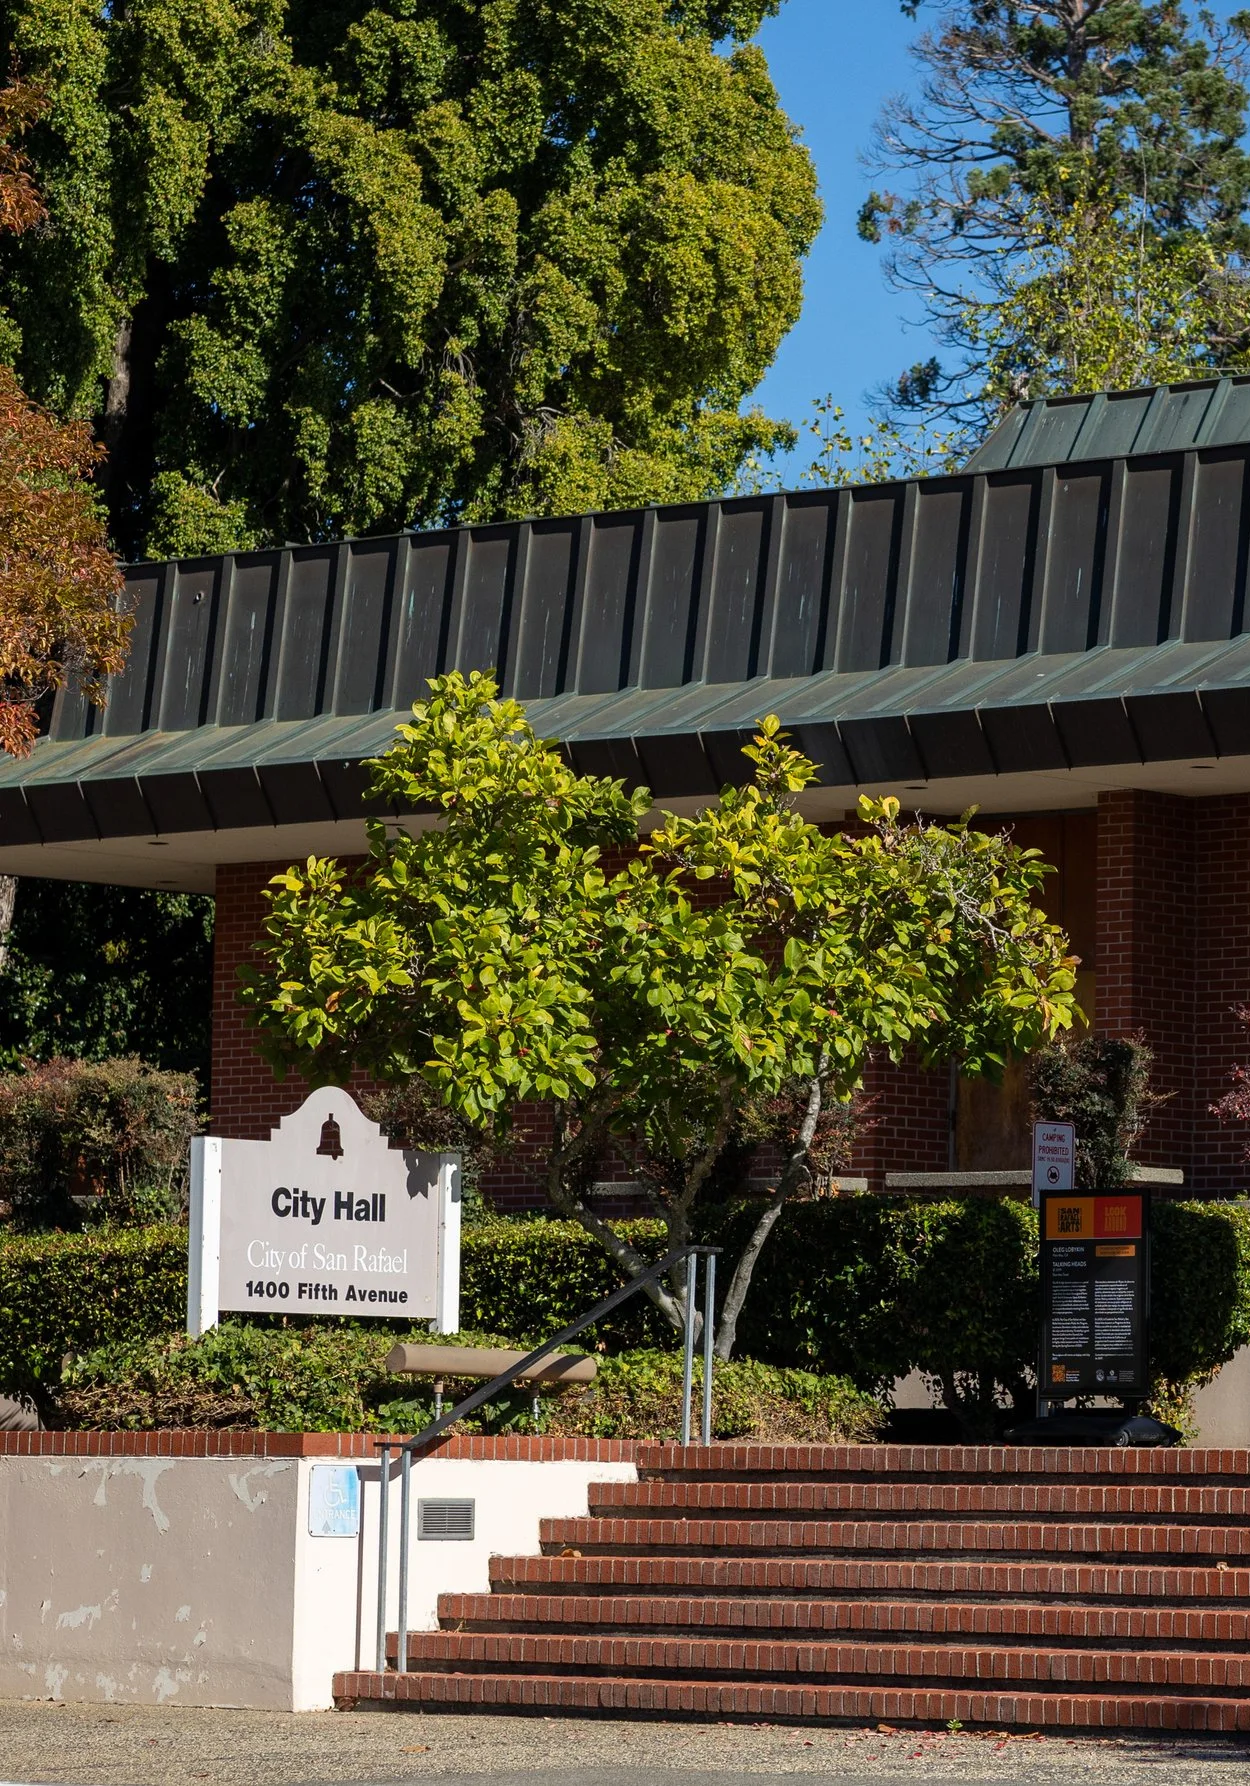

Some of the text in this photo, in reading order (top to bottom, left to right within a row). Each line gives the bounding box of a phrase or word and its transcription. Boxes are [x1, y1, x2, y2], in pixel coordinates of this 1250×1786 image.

[1043, 1133, 1065, 1143] CAMPING
[1039, 1146, 1069, 1155] PROHIBITED
[271, 1187, 386, 1225] City Hall
[1104, 1206, 1127, 1216] LOOK
[1060, 1221, 1080, 1232] ARTS
[247, 1240, 408, 1275] City of San Rafael
[246, 1280, 408, 1303] 1400 Fifth Avenue
